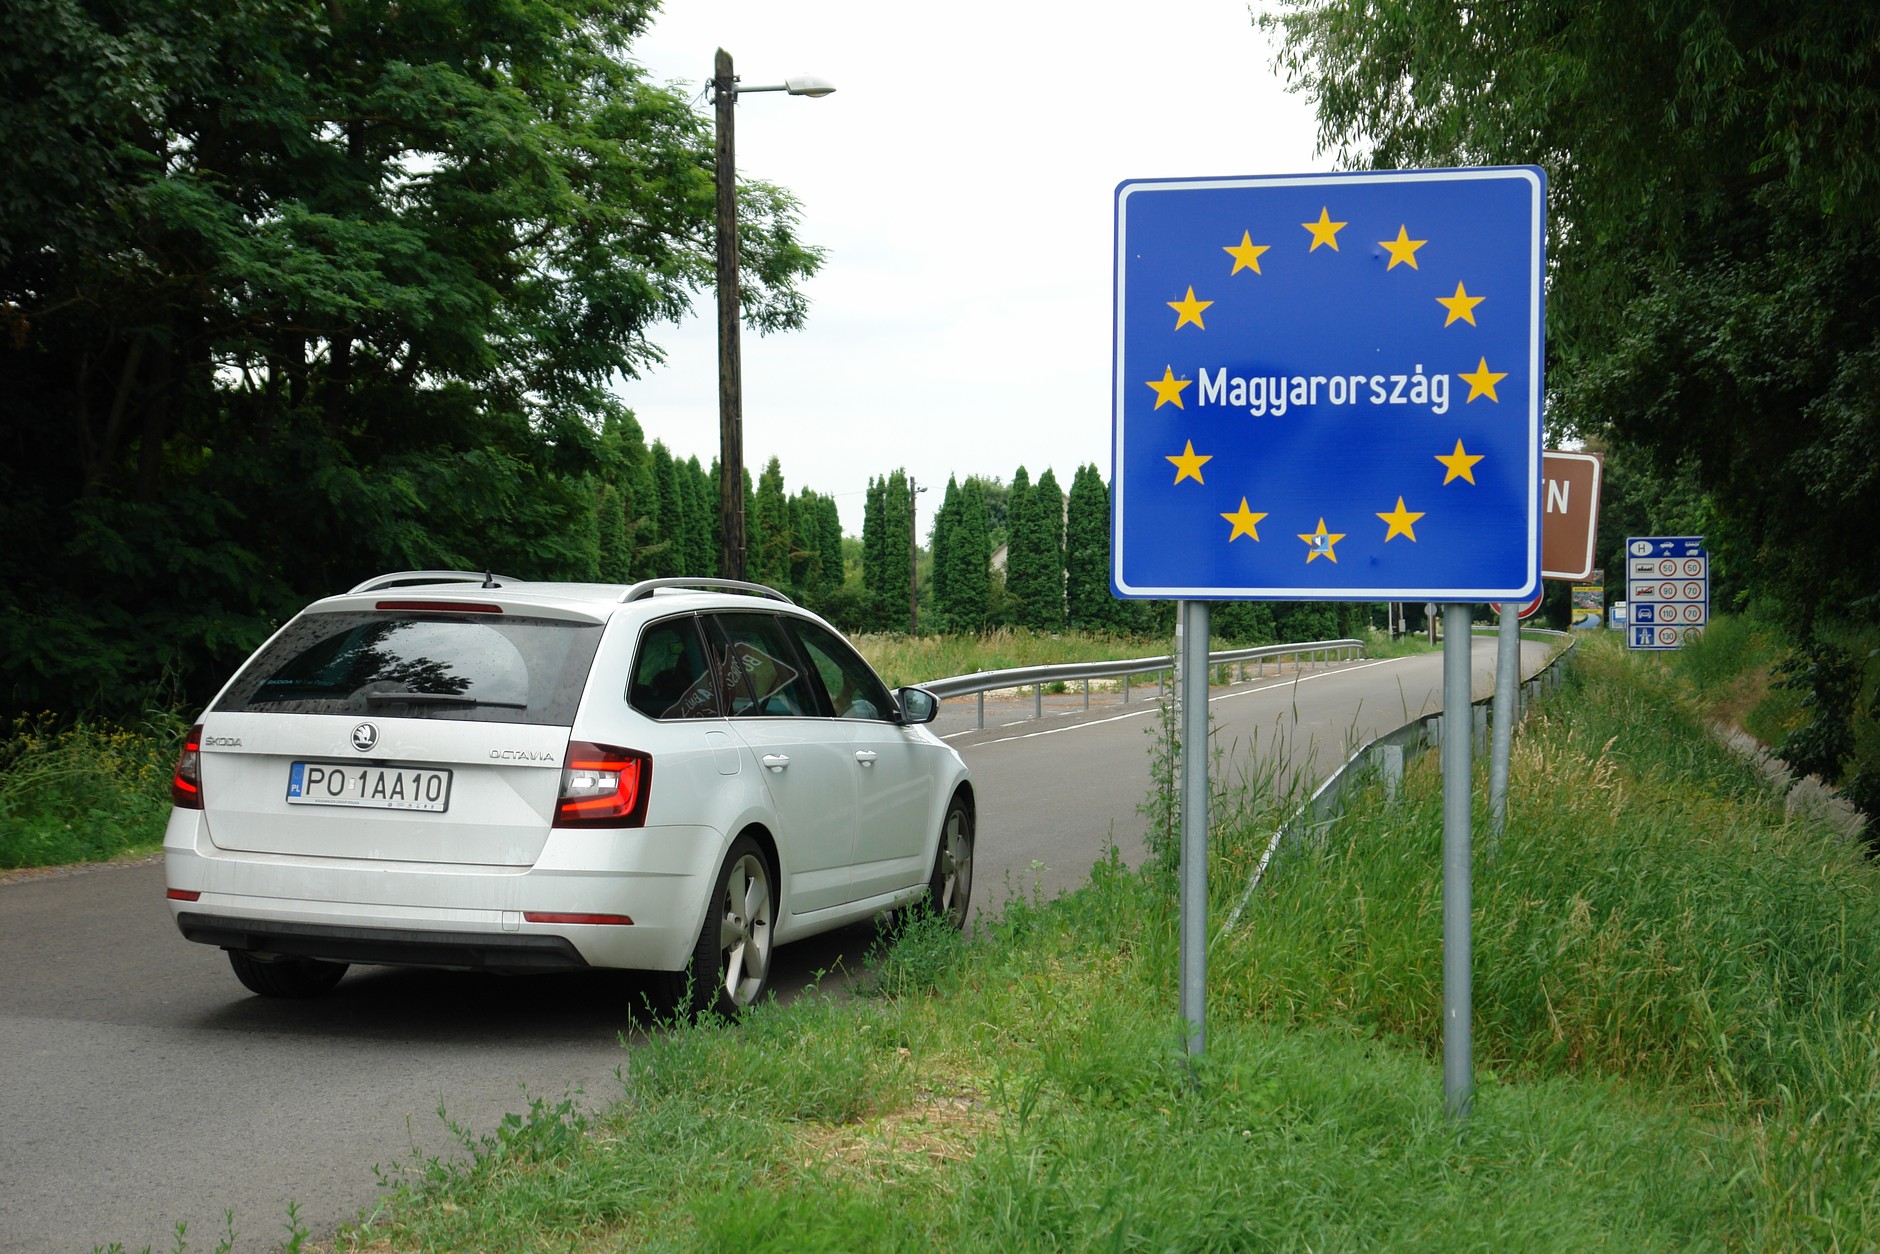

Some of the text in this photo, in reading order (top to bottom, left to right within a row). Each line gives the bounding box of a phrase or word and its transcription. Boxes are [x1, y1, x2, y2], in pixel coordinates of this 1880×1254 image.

[1198, 363, 1450, 417] Magyarország
[1542, 478, 1570, 515] N
[1637, 543, 1646, 553] H
[1663, 564, 1698, 572] 50 50
[1663, 587, 1698, 595] 90 70
[1662, 610, 1698, 618] 110 70
[1662, 632, 1674, 640] 130
[205, 736, 242, 747] ŠKODA
[489, 749, 555, 762] OCTAVIA
[290, 784, 301, 793] PL
[306, 767, 442, 803] PO 1AA10
